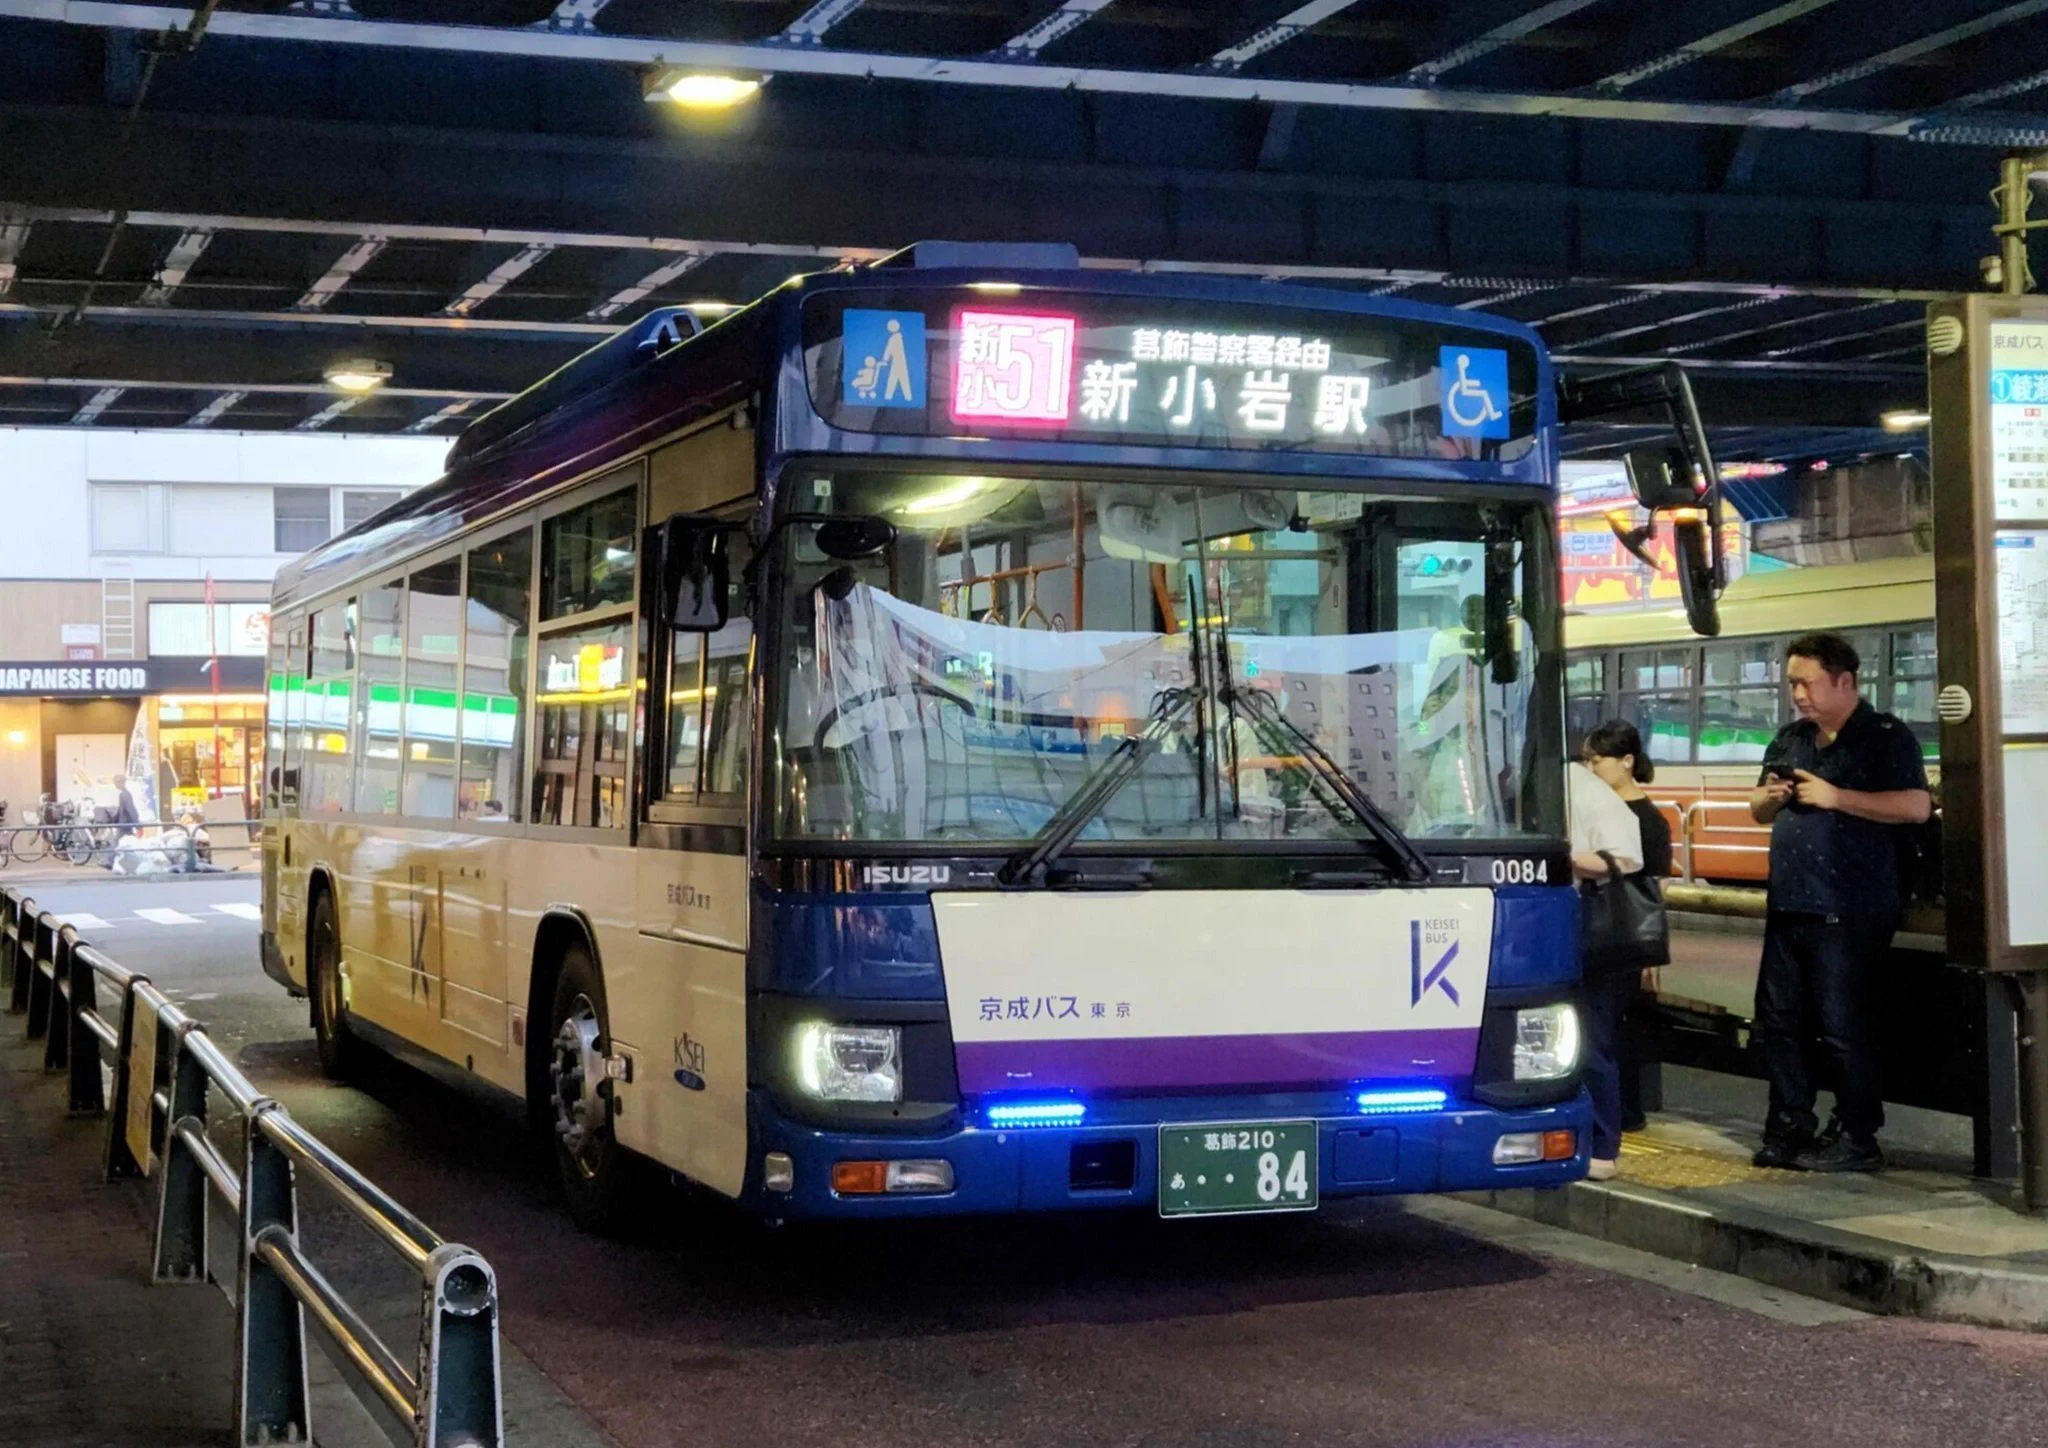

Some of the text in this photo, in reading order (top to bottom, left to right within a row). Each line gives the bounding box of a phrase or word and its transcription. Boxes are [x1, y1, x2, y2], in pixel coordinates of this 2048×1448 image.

[1132, 328, 1331, 370] 葛飾警察署経由
[996, 324, 1066, 413] 51
[1080, 359, 1370, 435] 新小岩駅
[0, 668, 146, 690] JAPANESE FOOD
[864, 866, 949, 884] ISUZU
[1491, 859, 1548, 884] 0084
[1425, 919, 1460, 930] KEISEI
[1425, 933, 1448, 943] BUS
[979, 995, 1131, 1021] 京成バス 東京
[1170, 1150, 1308, 1201] あ 84
